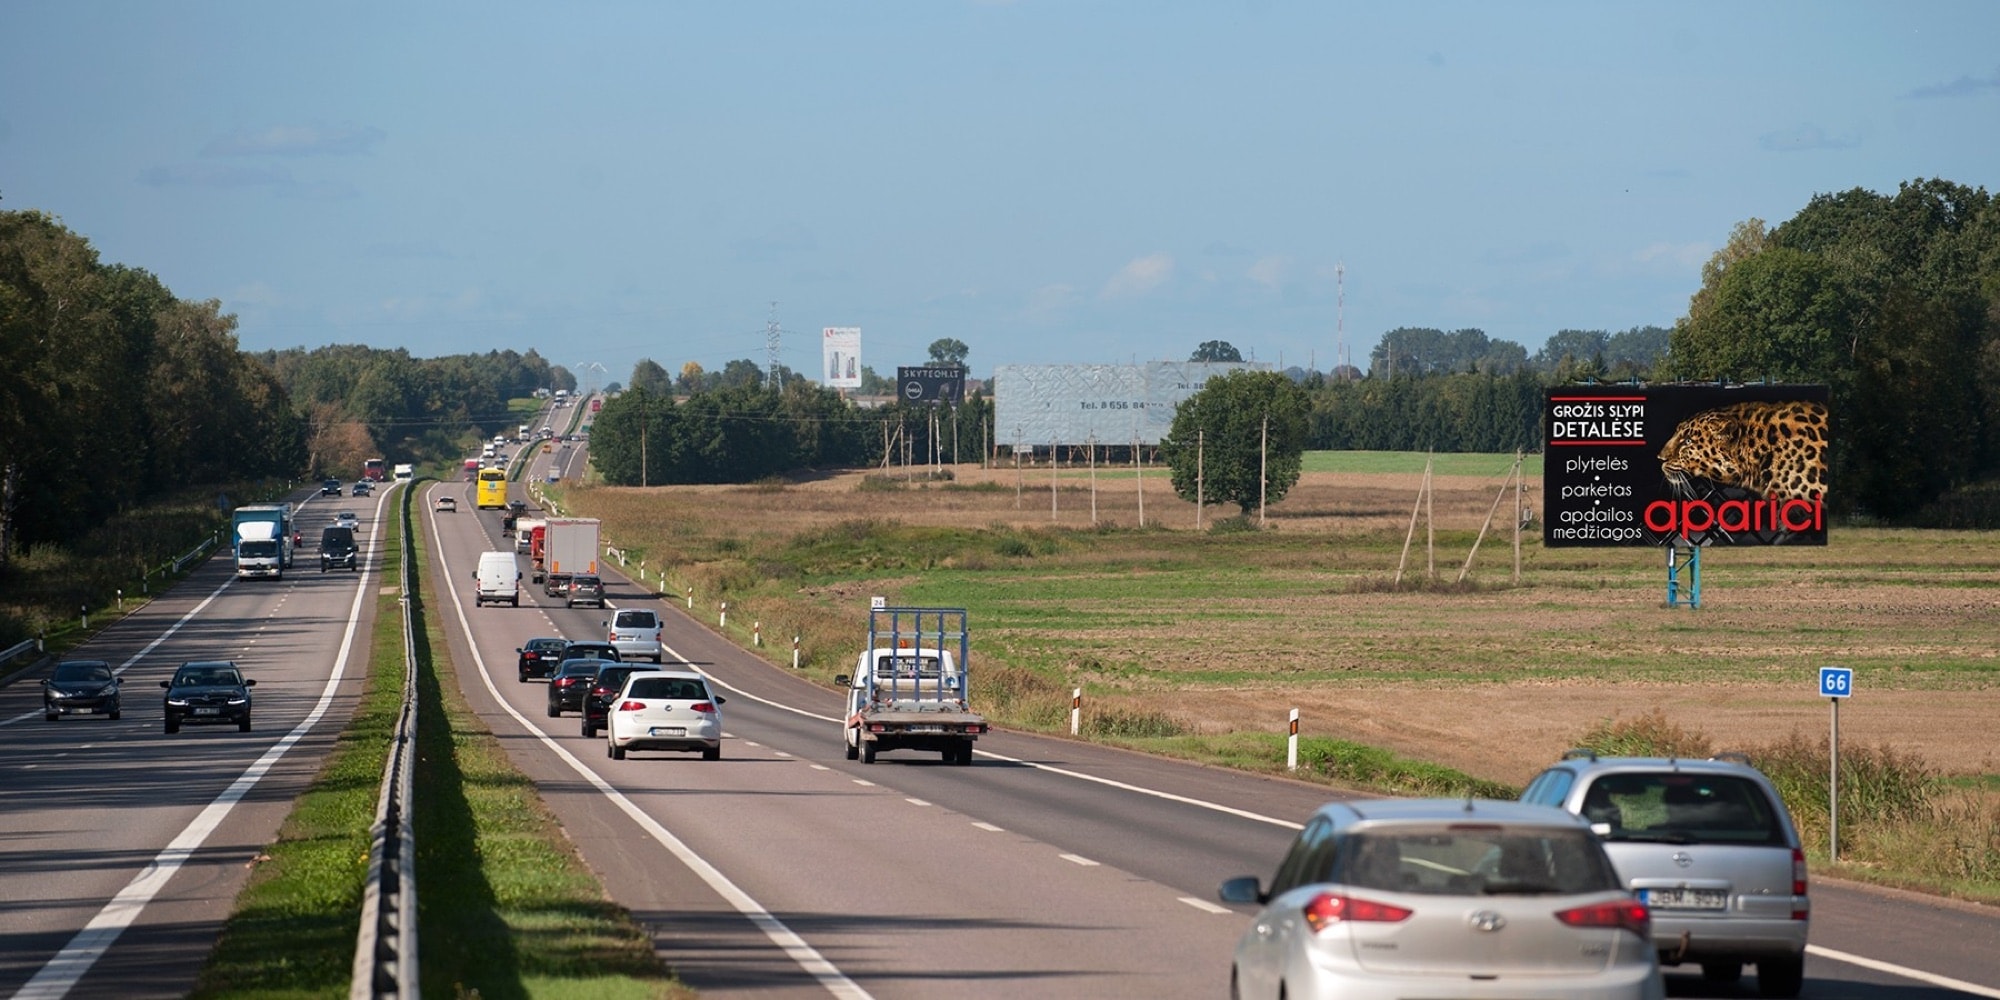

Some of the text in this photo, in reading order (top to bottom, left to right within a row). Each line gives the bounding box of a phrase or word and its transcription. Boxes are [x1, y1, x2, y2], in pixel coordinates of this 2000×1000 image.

[903, 370, 960, 378] SKYTECH.LT
[1552, 402, 1645, 418] GROŽIS SLYPI
[1552, 418, 1645, 438] DETALĖSE
[1566, 455, 1629, 473] plytelės
[1561, 483, 1632, 500] parketas
[1560, 507, 1633, 524] apdailos
[1644, 491, 1822, 540] aparici
[1553, 524, 1642, 541] medžiagos
[1826, 673, 1847, 691] 66
